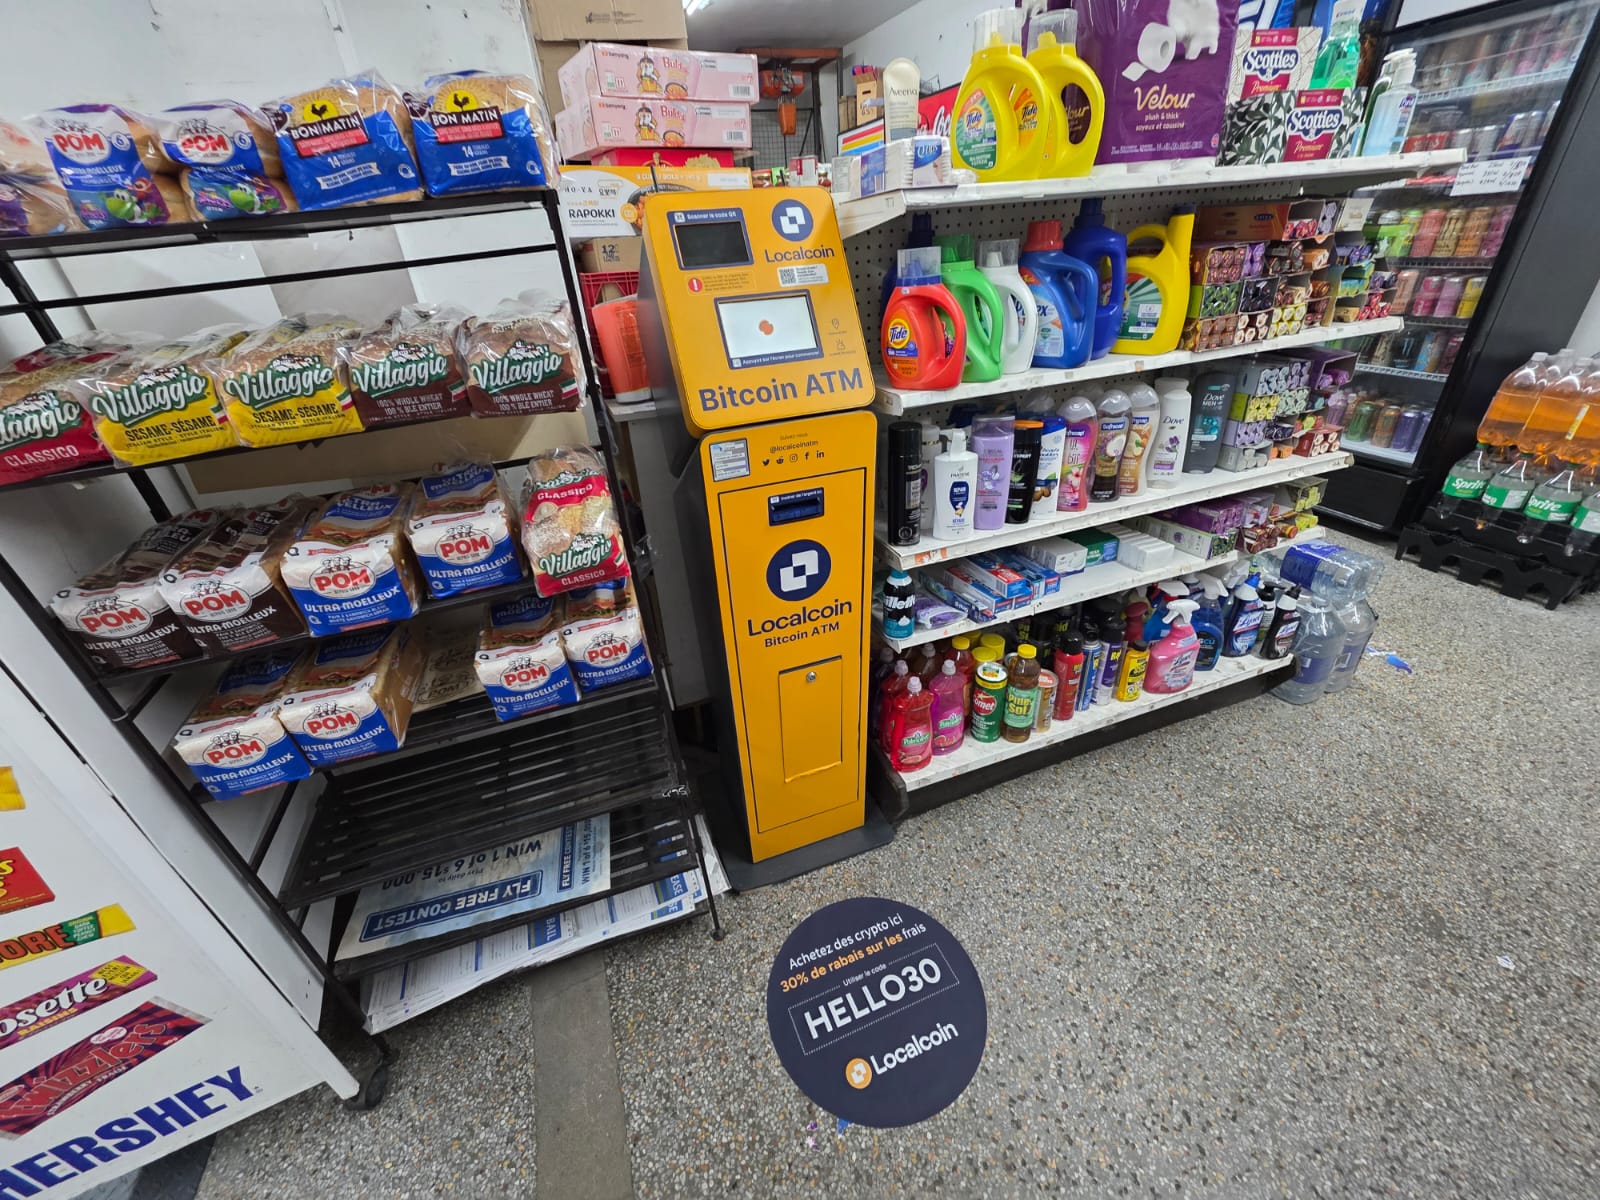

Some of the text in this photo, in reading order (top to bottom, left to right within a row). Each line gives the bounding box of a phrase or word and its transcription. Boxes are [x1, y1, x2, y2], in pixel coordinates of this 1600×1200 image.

[1244, 49, 1297, 72] Scotties
[889, 88, 918, 97] Aveeno
[1133, 84, 1195, 111] Velour
[291, 114, 361, 140] BON MATIN
[431, 109, 499, 126] BON MATIN
[1145, 112, 1160, 121] plush
[1166, 110, 1179, 120] thick
[1288, 109, 1340, 131] Scotties
[54, 132, 104, 153] POM
[116, 137, 124, 146] 6
[181, 135, 228, 154] POM
[239, 136, 247, 147] 6
[462, 145, 474, 158] 14
[327, 156, 340, 168] 14
[568, 208, 616, 218] RAPOKKI
[687, 212, 708, 220] Scanner
[714, 210, 728, 218] code
[602, 244, 616, 254] 12
[764, 244, 835, 264] Localcoin
[890, 326, 908, 342] Tide
[225, 357, 335, 405] Villaggio
[351, 350, 448, 393] Villaggio
[471, 350, 563, 392] Villaggio
[92, 371, 207, 421] Villaggio
[396, 396, 419, 406] WHOLE
[419, 392, 443, 403] WHEAT
[511, 394, 532, 404] WHOLE
[532, 390, 555, 402] WHEAT
[699, 367, 864, 412] Bitcoin ATM
[252, 400, 339, 424] SESAME-SÉSAME
[385, 406, 398, 416] 100
[418, 402, 442, 411] ENTIER
[530, 398, 554, 408] ENTIER
[124, 413, 217, 442] SESAME-SÉSAME
[1162, 416, 1184, 425] Dove
[4, 445, 80, 467] CLASSICO
[537, 484, 593, 500] CLASSICO
[439, 536, 490, 559] POM
[429, 552, 514, 579] ULTRA-MOELLEUX
[561, 569, 606, 586] CLASSICO
[314, 568, 371, 592] POM
[184, 589, 248, 614] POM
[304, 586, 400, 613] ULTRA-MOELLEUX
[80, 608, 146, 633] POM
[187, 604, 277, 635] ULTRA-MOELLEUX
[747, 599, 853, 637] Localcoin
[84, 622, 180, 652] ULTRA-MOELLEUX
[764, 622, 840, 648] Bitcoin ATM
[587, 643, 628, 662] POM
[503, 662, 548, 686] POM
[578, 655, 647, 679] ULTRA-MOELLEUX
[494, 678, 569, 704] ULTRA-MOELLEUX
[1008, 703, 1028, 716] Sol
[306, 712, 357, 734] POM
[300, 724, 386, 753] ULTRA-MOELLEUX
[206, 740, 264, 764] POM
[202, 752, 295, 784] ULTRA-MOELLEUX
[506, 839, 542, 858] WIN
[372, 878, 532, 932] FLY FREE CONTEST
[0, 924, 78, 962] ORE
[789, 912, 903, 970] Achetez des crypto ici
[780, 922, 927, 993] 30% de rabais sur les frais
[842, 962, 887, 988] Utiliser le code
[804, 958, 942, 1040] HELLO30
[870, 1022, 960, 1076] Localcoin
